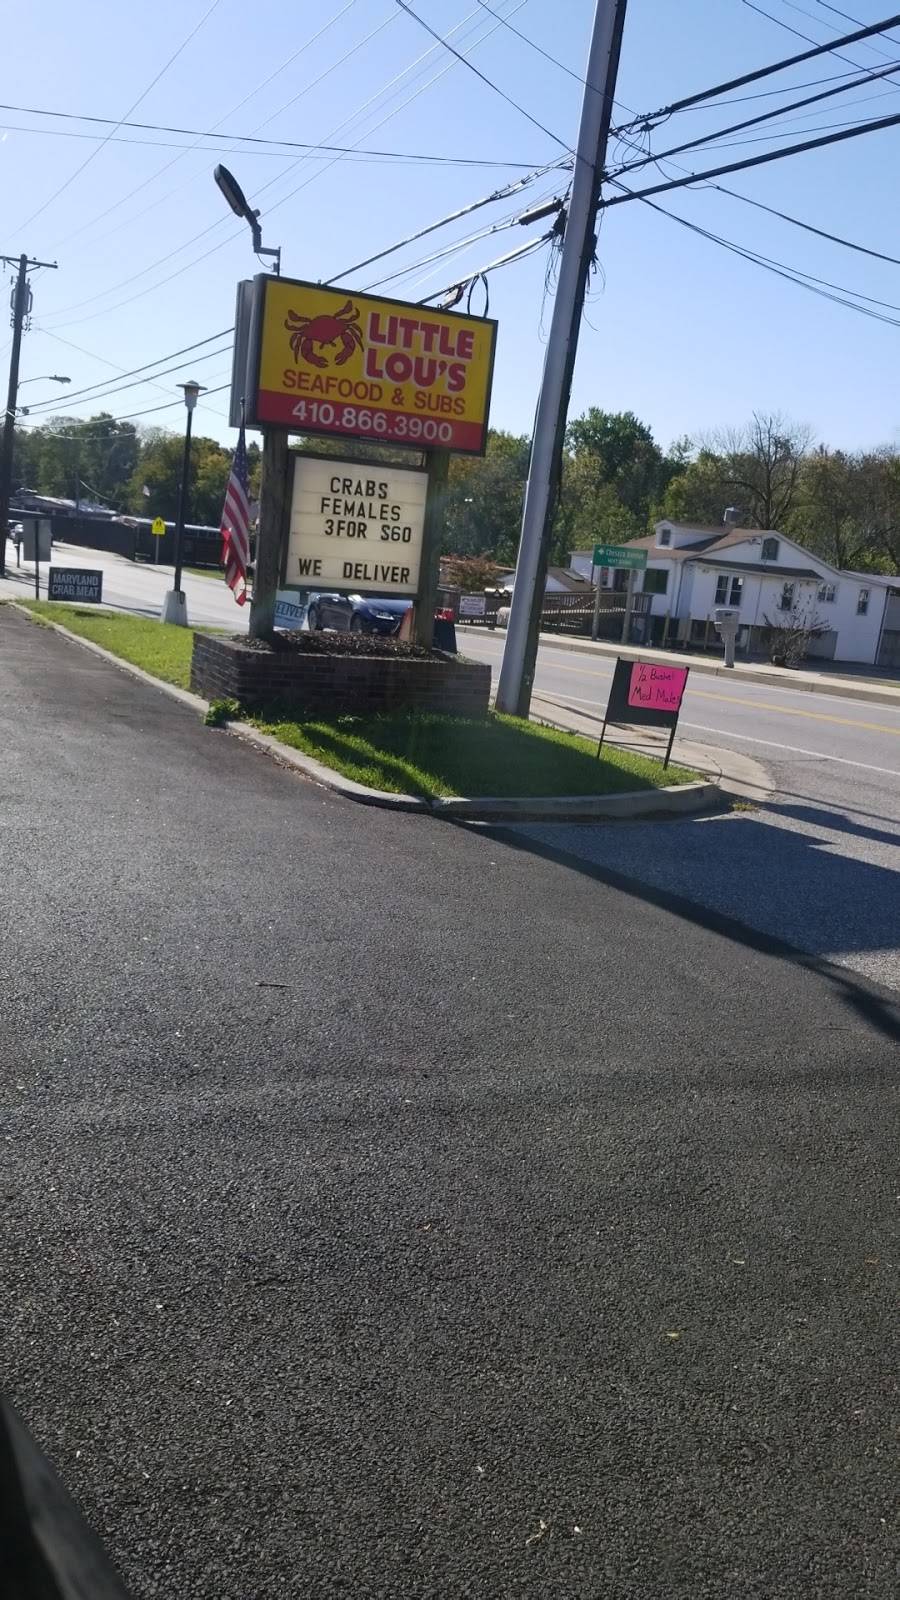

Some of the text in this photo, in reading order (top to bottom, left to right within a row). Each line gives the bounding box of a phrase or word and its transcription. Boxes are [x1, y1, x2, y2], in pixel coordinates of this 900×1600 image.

[368, 312, 474, 359] LITTLE
[365, 348, 467, 392] LOU'S
[282, 369, 466, 415] SEAFOOD & SUBS
[292, 400, 453, 442] 410.866.3900
[330, 477, 388, 499] CRABS
[321, 497, 401, 521] FEMALES
[53, 573, 99, 586] MARYLAND
[298, 558, 410, 584] WE DELIVER
[52, 584, 99, 598] CRAB MEAT
[631, 685, 652, 702] Med
